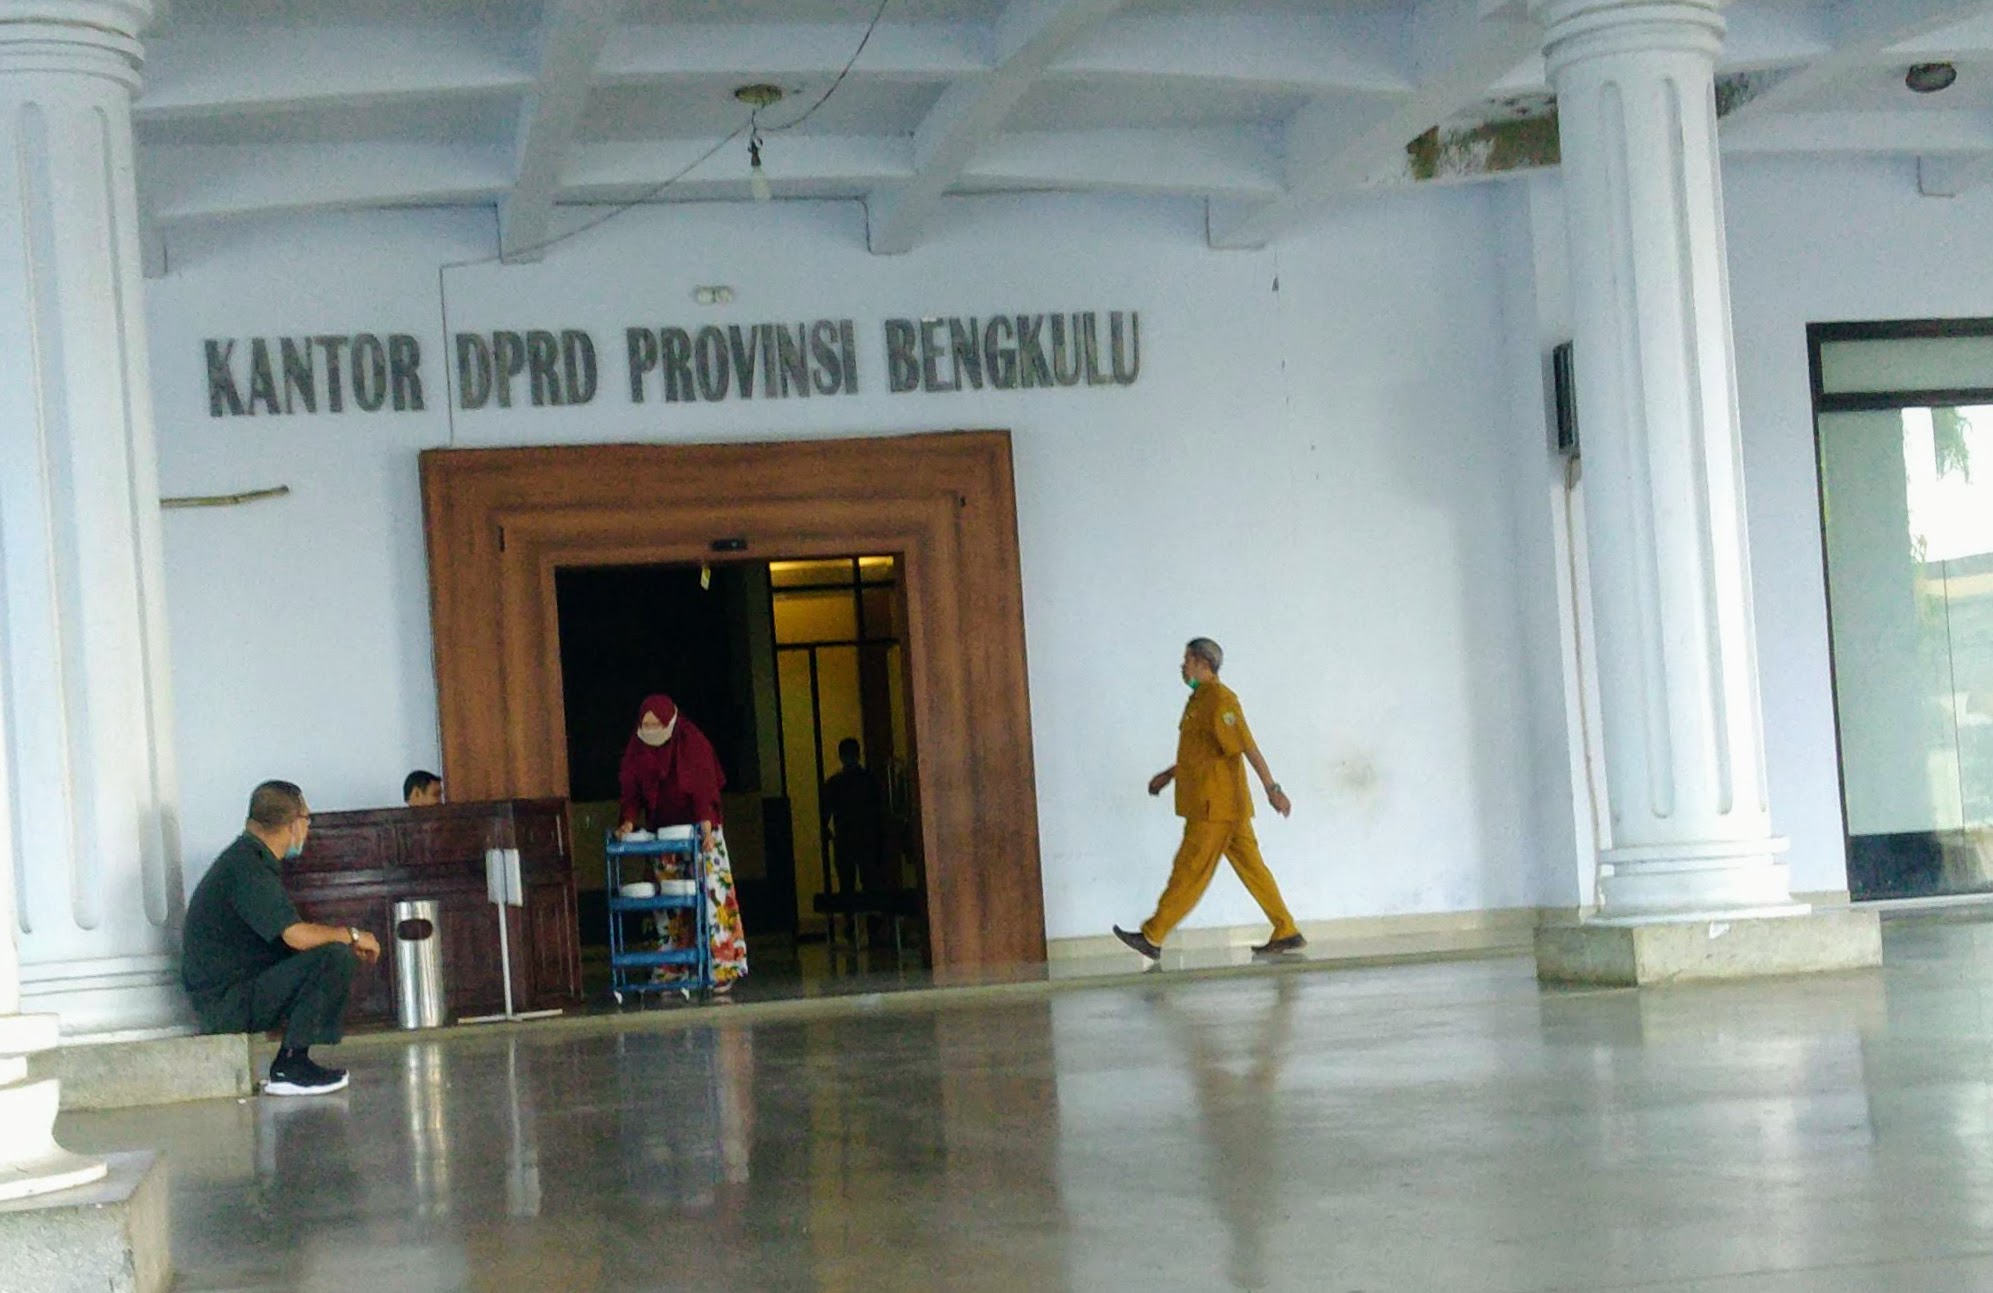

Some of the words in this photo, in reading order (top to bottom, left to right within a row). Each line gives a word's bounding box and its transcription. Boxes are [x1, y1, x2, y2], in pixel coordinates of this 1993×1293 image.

[204, 333, 425, 417] KANTOR
[455, 329, 598, 410] DPRD
[626, 318, 859, 403] PROVINSI
[884, 310, 1141, 394] BENGKULU
